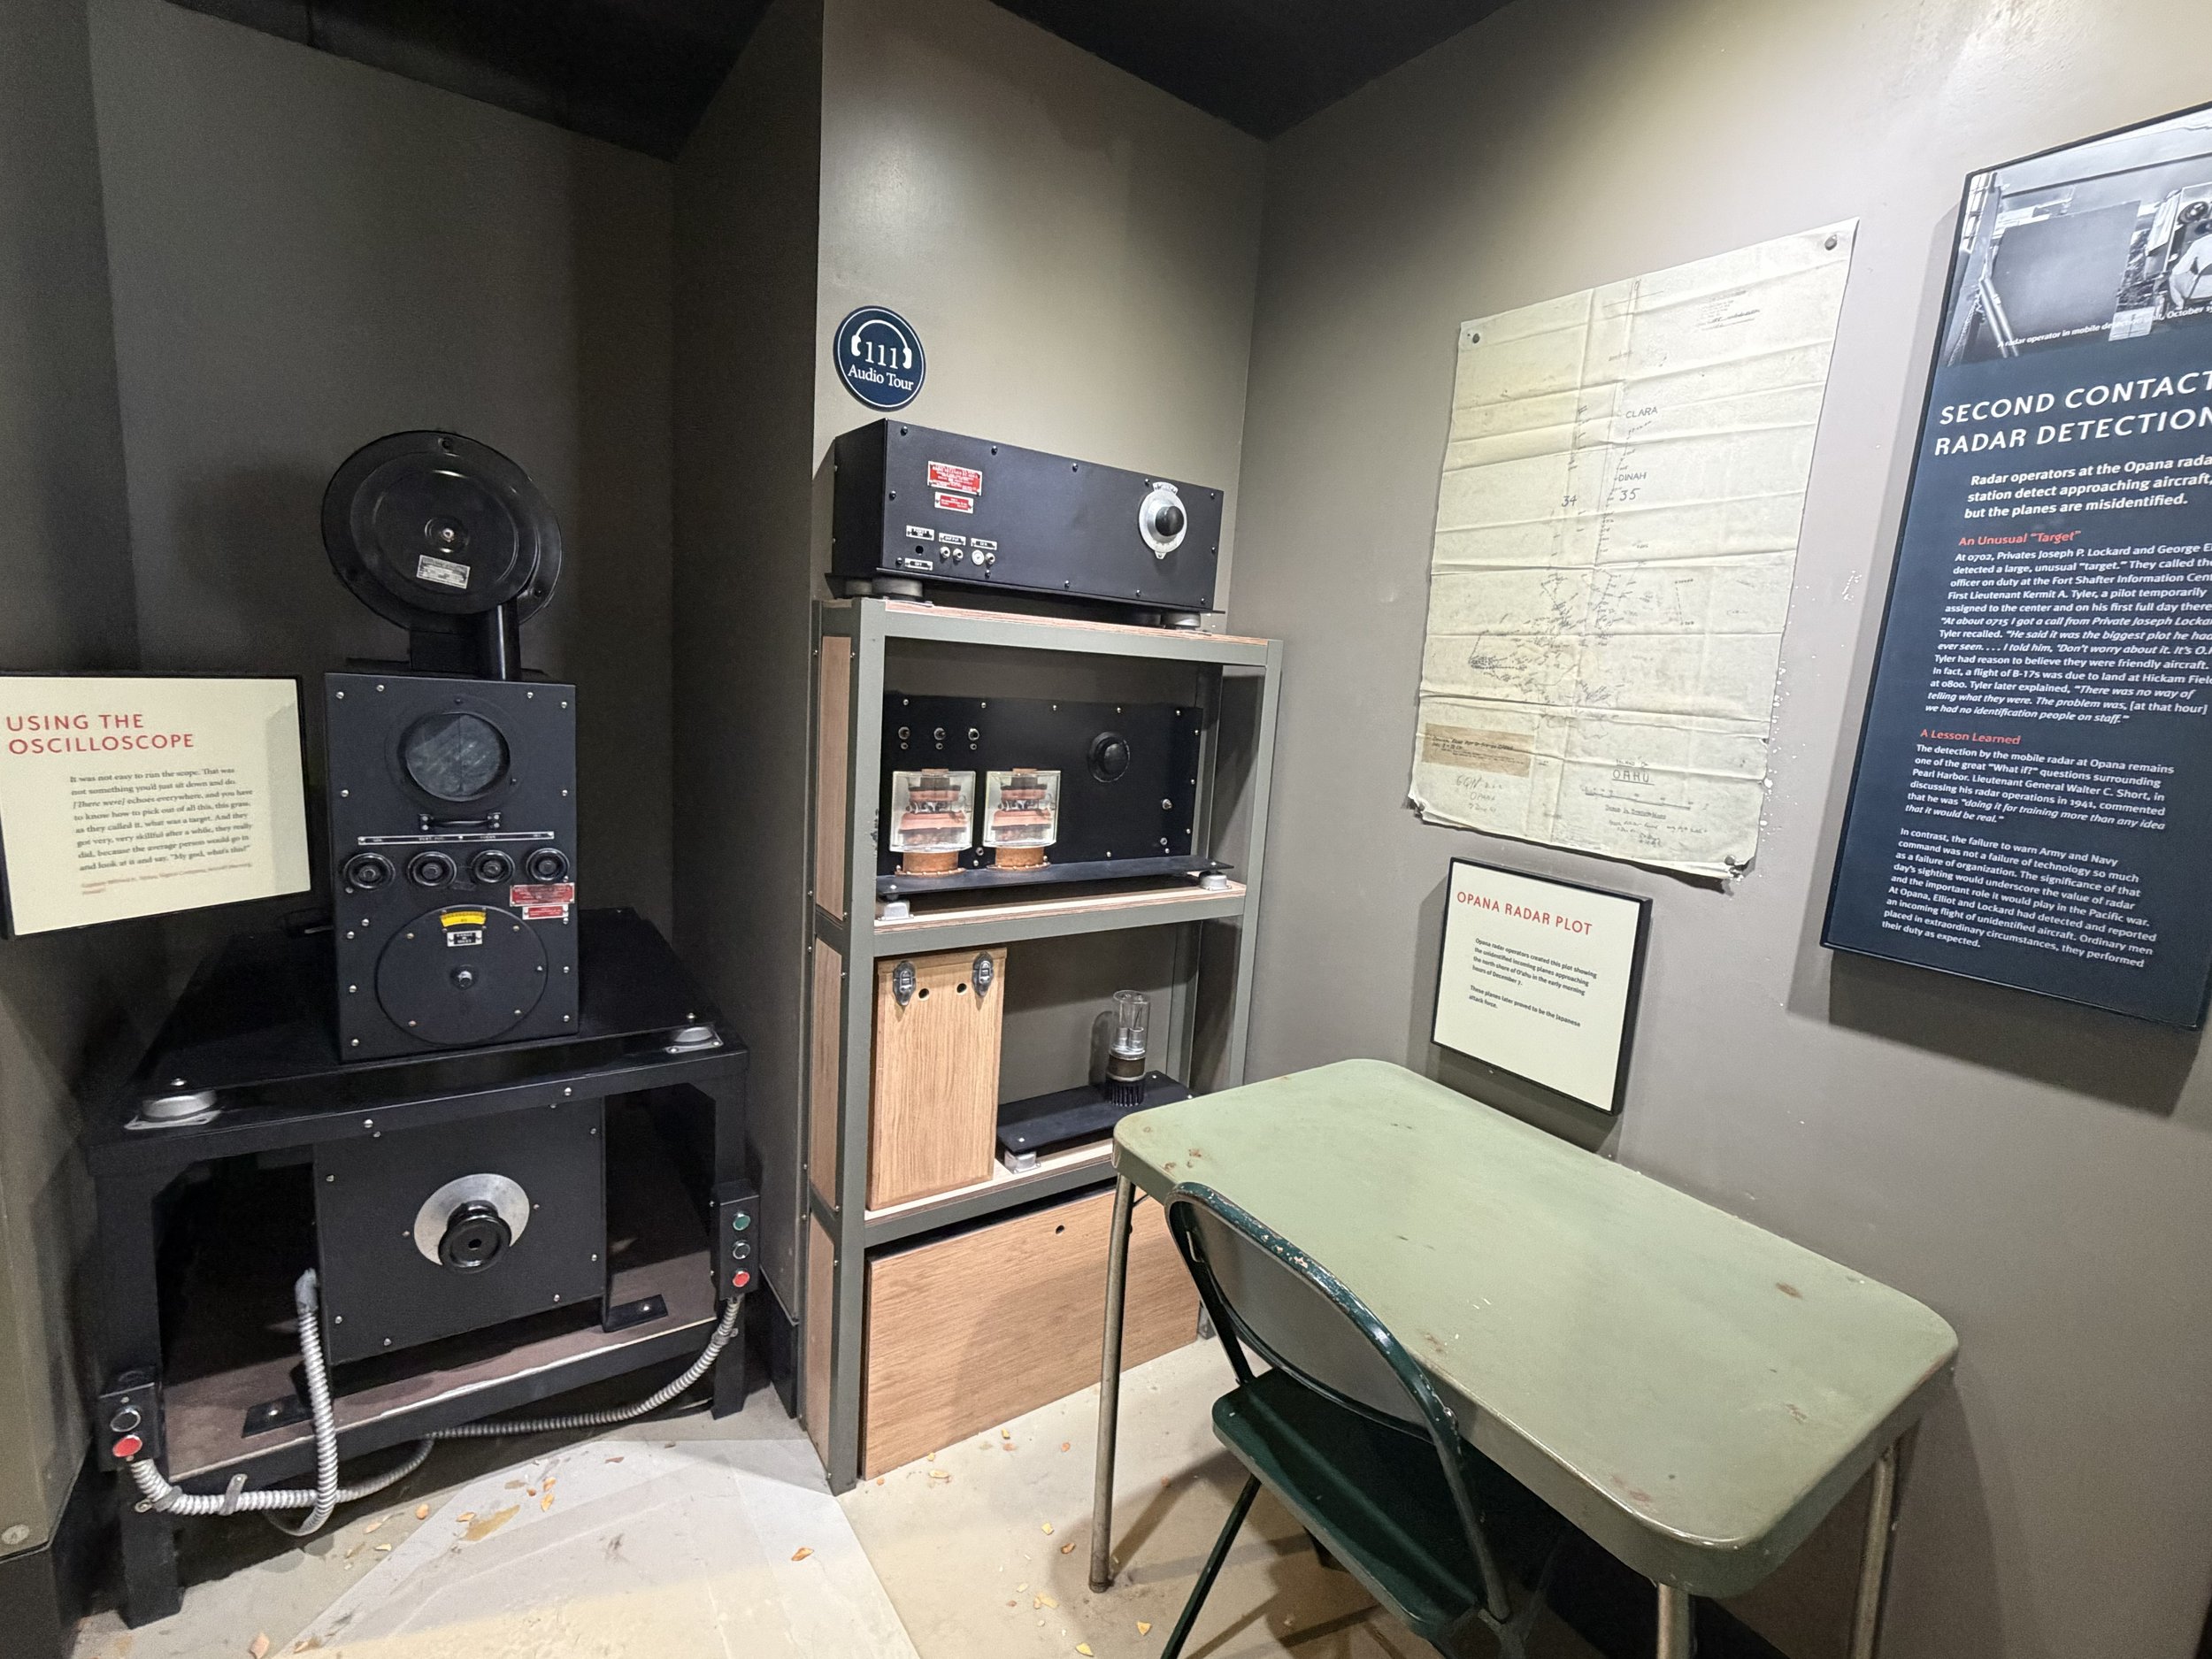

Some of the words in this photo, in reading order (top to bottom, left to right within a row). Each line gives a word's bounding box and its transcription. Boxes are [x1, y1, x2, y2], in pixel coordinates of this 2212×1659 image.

[2167, 307, 2204, 319] October
[865, 342, 898, 369] 111
[848, 365, 884, 384] Audio
[886, 373, 914, 391] Tour
[1625, 407, 1658, 419] CLARA
[1939, 393, 2055, 425] SECOND
[1934, 428, 2027, 456] RADAR
[1618, 472, 1647, 482] DINAH
[1970, 473, 2009, 486] Radar
[2010, 468, 2076, 484] operators
[2078, 465, 2094, 477] at
[2096, 463, 2121, 475] the
[2124, 460, 2174, 474] Opana
[1619, 488, 1640, 501] 35
[1967, 489, 2012, 502] station
[2014, 485, 2057, 499] detect
[2059, 479, 2151, 497] approaching
[1561, 495, 1577, 507] 34
[1964, 508, 1986, 519] but
[1988, 506, 2010, 517] the
[2011, 504, 2057, 518] planes
[2059, 503, 2083, 512] are
[2085, 492, 2188, 511] misidentified.
[1959, 537, 1975, 546] An
[1978, 534, 2028, 545] Unusual
[1947, 591, 1969, 600] First
[1969, 591, 2022, 600] Lieutenant
[2022, 589, 2057, 599] Kermit
[2057, 590, 2068, 598] A.
[2071, 590, 2098, 600] Tyler,
[2109, 588, 2137, 599] pilot
[2139, 587, 2207, 599] temporarily
[1934, 654, 1957, 664] Tyler
[1957, 655, 1976, 663] had
[2024, 656, 2062, 666] believe
[2063, 657, 2088, 668] they
[2117, 658, 2162, 670] friendly
[2162, 660, 2209, 670] aircraft.
[1939, 704, 1959, 713] had
[1973, 706, 2038, 718] identification
[2038, 711, 2076, 721] people
[6, 714, 88, 731] USING
[99, 714, 144, 729] THE
[8, 734, 194, 754] OSCILLOSCOPE
[1920, 729, 1928, 738] A
[1931, 731, 1970, 741] Lesson
[1972, 733, 2021, 745] Learned
[1916, 743, 1933, 753] The
[1933, 745, 1977, 757] detection
[1978, 749, 1992, 759] by
[1992, 750, 2009, 760] the
[2010, 753, 2045, 763] mobile
[2046, 756, 2075, 765] radar
[2089, 759, 2126, 770] Opana
[2128, 763, 2174, 774] remains
[1905, 804, 1924, 813] that
[1924, 806, 1932, 814] it
[1933, 809, 1963, 818] would
[1962, 811, 1976, 820] be
[1457, 891, 1500, 912] OPANA
[1505, 903, 1551, 925] RADAR
[1556, 917, 1592, 935] PLOT
[1882, 920, 1902, 931] their
[1902, 925, 1923, 936] duty
[1936, 934, 1981, 947] expected.
[1475, 938, 1491, 947] Opana
[1505, 948, 1529, 958] operators
[1530, 955, 1550, 964] created
[1574, 967, 1597, 979] showing
[1472, 964, 1486, 973] hours
[1492, 971, 1517, 983] December
[1483, 951, 1512, 962] unidentified
[1512, 958, 1536, 971] incoming
[1536, 966, 1554, 975] planes
[1555, 972, 1589, 987] approaching
[1548, 980, 1561, 988] early
[1562, 984, 1585, 996] morning
[1469, 995, 1483, 1003] attack
[1484, 999, 1497, 1008] force.
[1470, 985, 1484, 994] These
[1484, 991, 1501, 1000] planes
[1514, 1001, 1531, 1010] proved
[1555, 1014, 1580, 1027] Japanese
